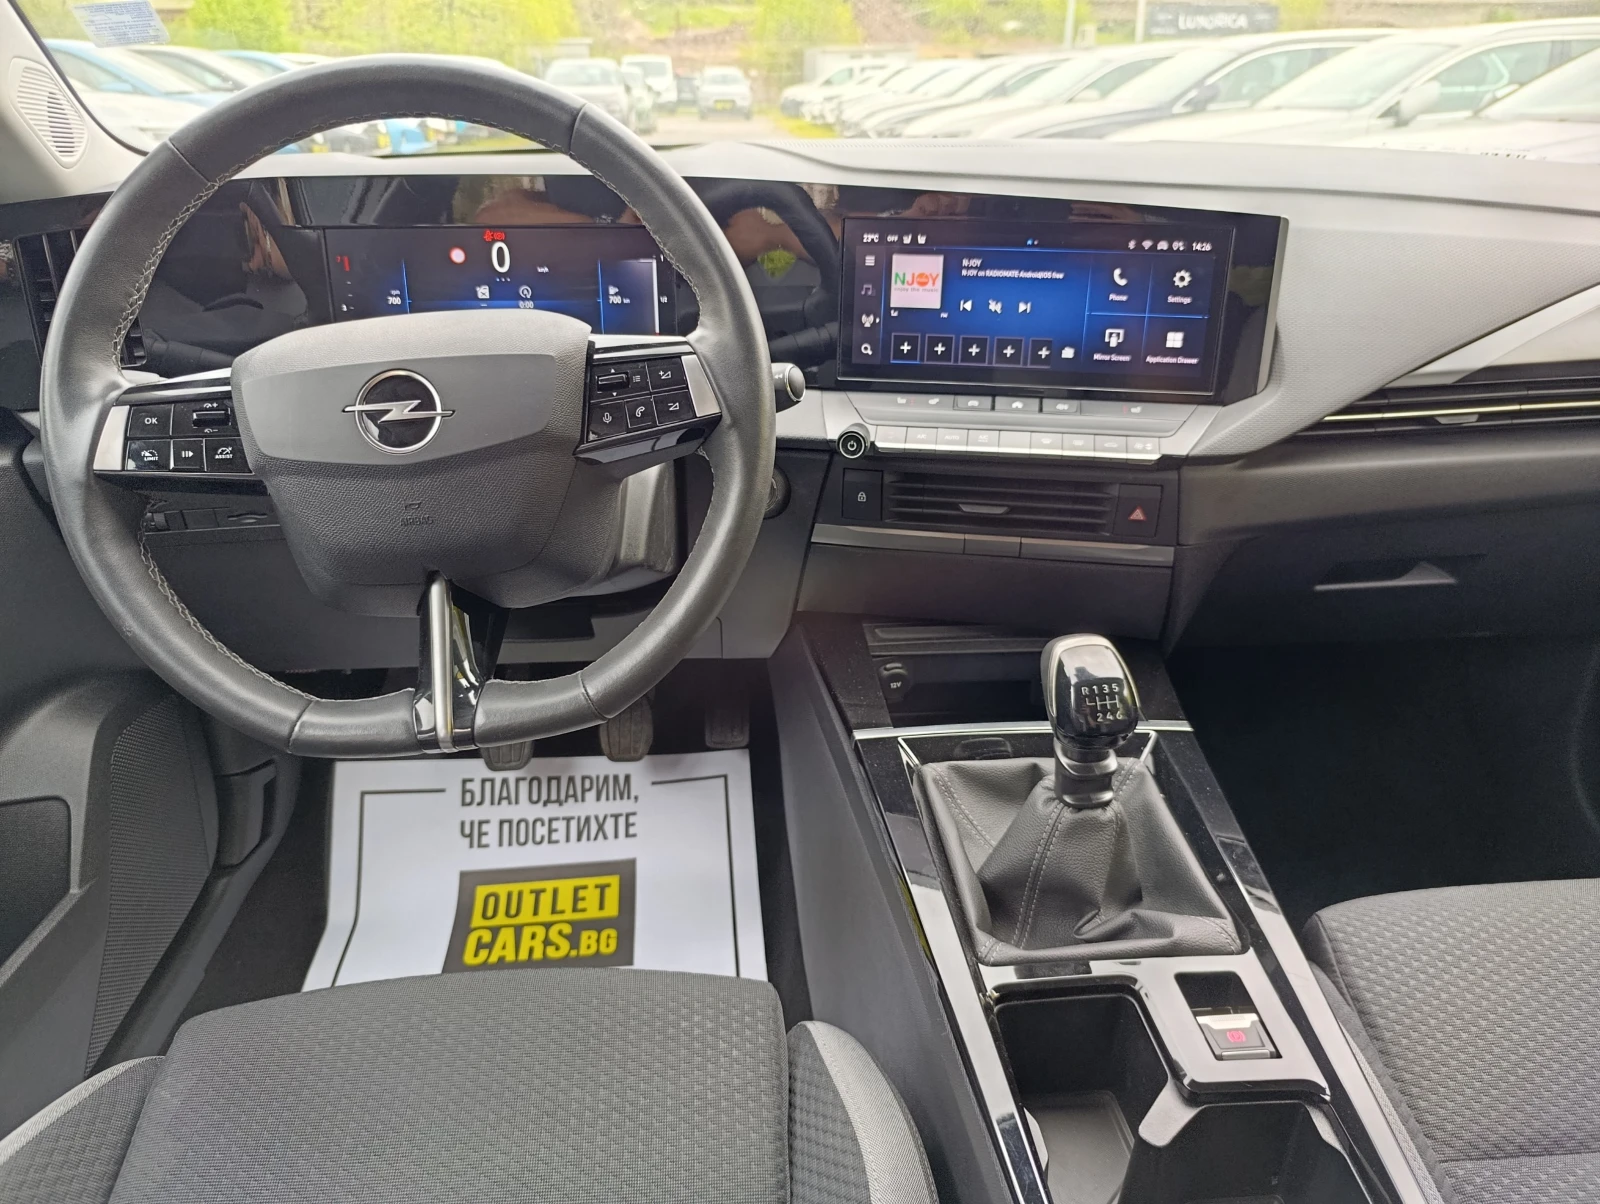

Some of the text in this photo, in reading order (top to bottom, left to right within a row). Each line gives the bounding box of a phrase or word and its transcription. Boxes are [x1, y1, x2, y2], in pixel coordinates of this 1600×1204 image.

[863, 234, 879, 243] 23°C
[1192, 241, 1212, 252] 14:26
[491, 241, 511, 273] 0
[387, 296, 402, 305] 700
[609, 295, 622, 304] 700
[1109, 293, 1128, 301] Phone
[1168, 295, 1192, 304] Settings
[519, 300, 534, 309] 0:00
[1093, 353, 1111, 361] Mirror
[1145, 355, 1199, 364] Application Drawer
[144, 417, 158, 425] OK
[1081, 683, 1119, 696] R 1 3 5
[1097, 711, 1123, 722] 2 4 6
[461, 773, 639, 807] БЛАГОДАРИМ,
[460, 811, 638, 849] ЧЕ ПОСЕТИХТЕ
[481, 882, 612, 921] OUTLET
[462, 921, 618, 967] CARS.BG
